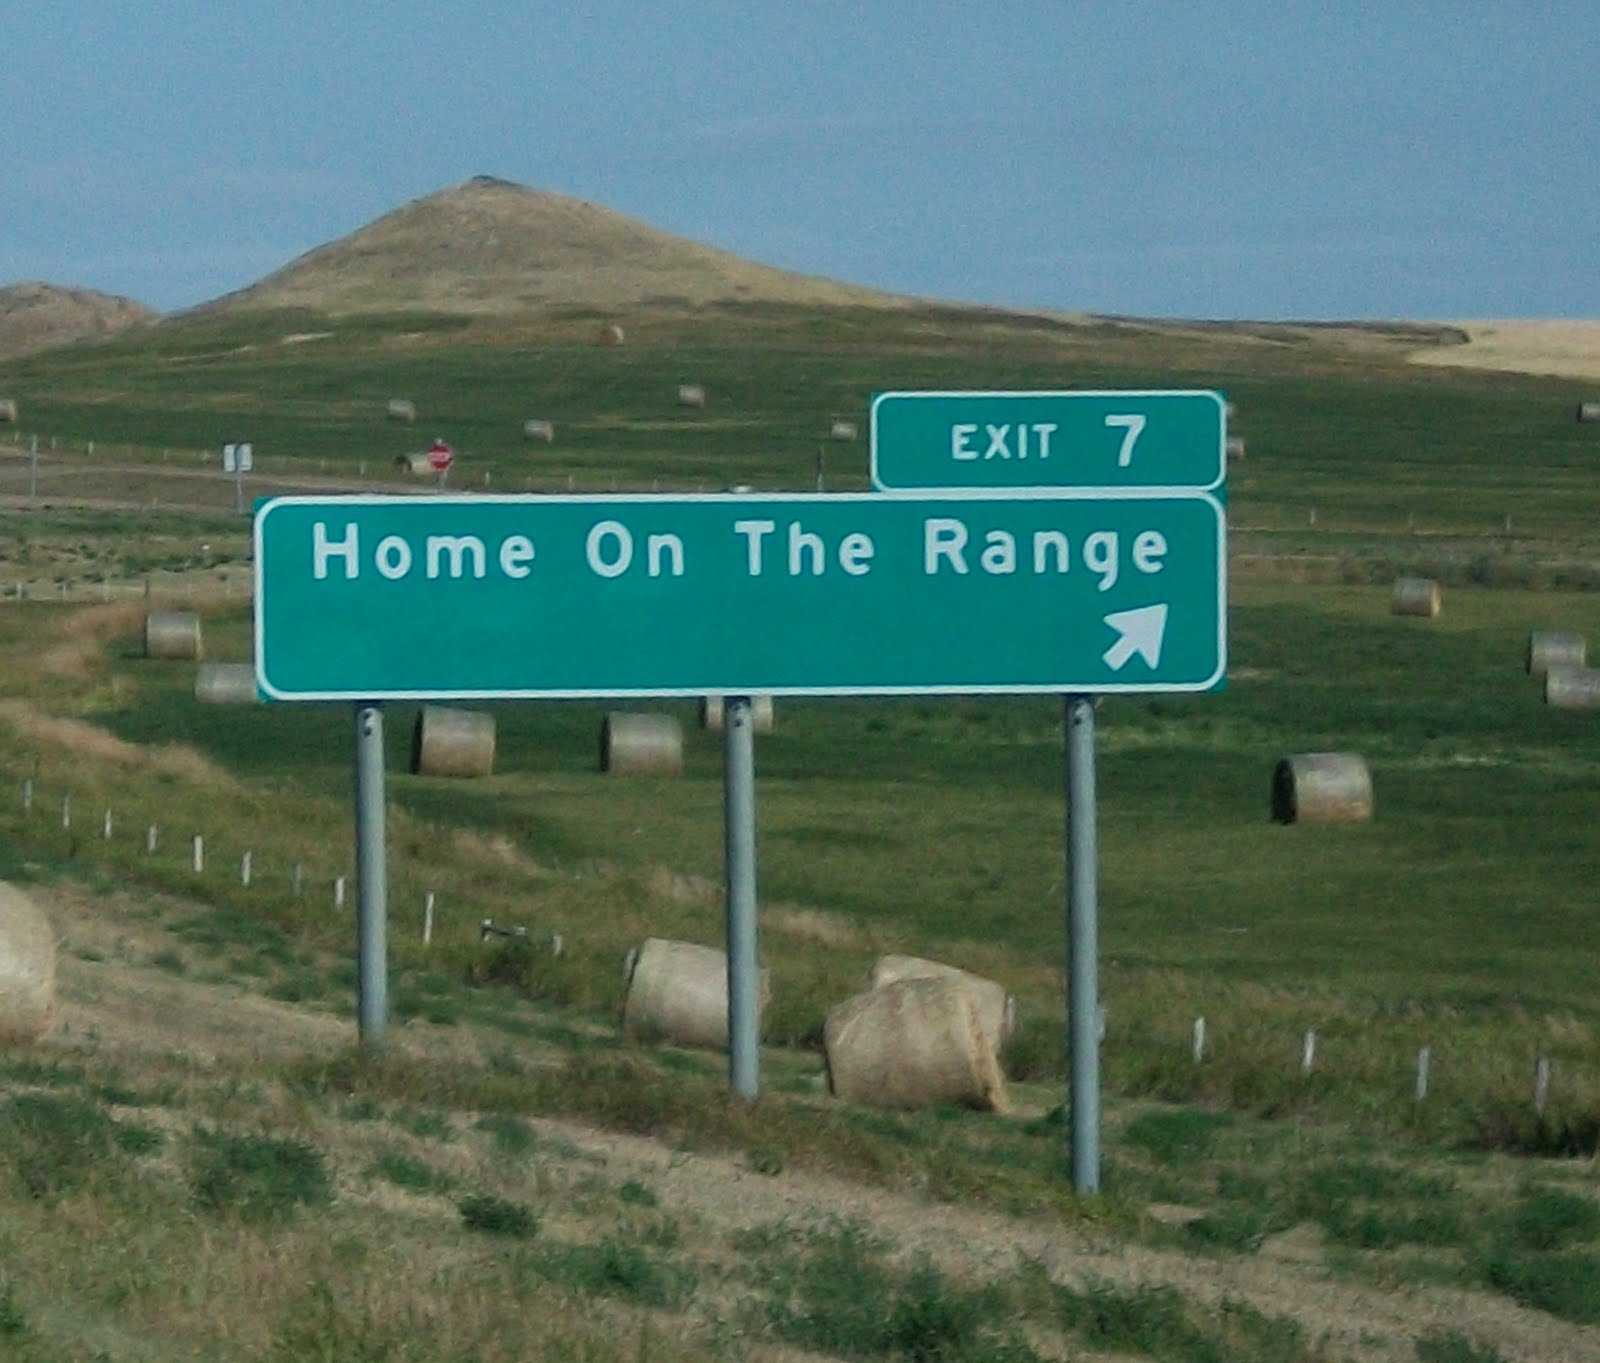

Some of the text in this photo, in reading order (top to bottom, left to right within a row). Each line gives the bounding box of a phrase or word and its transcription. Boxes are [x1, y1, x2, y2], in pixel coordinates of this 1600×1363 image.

[951, 414, 1147, 468] EXIT 7
[312, 517, 1168, 592] Home On The Range
